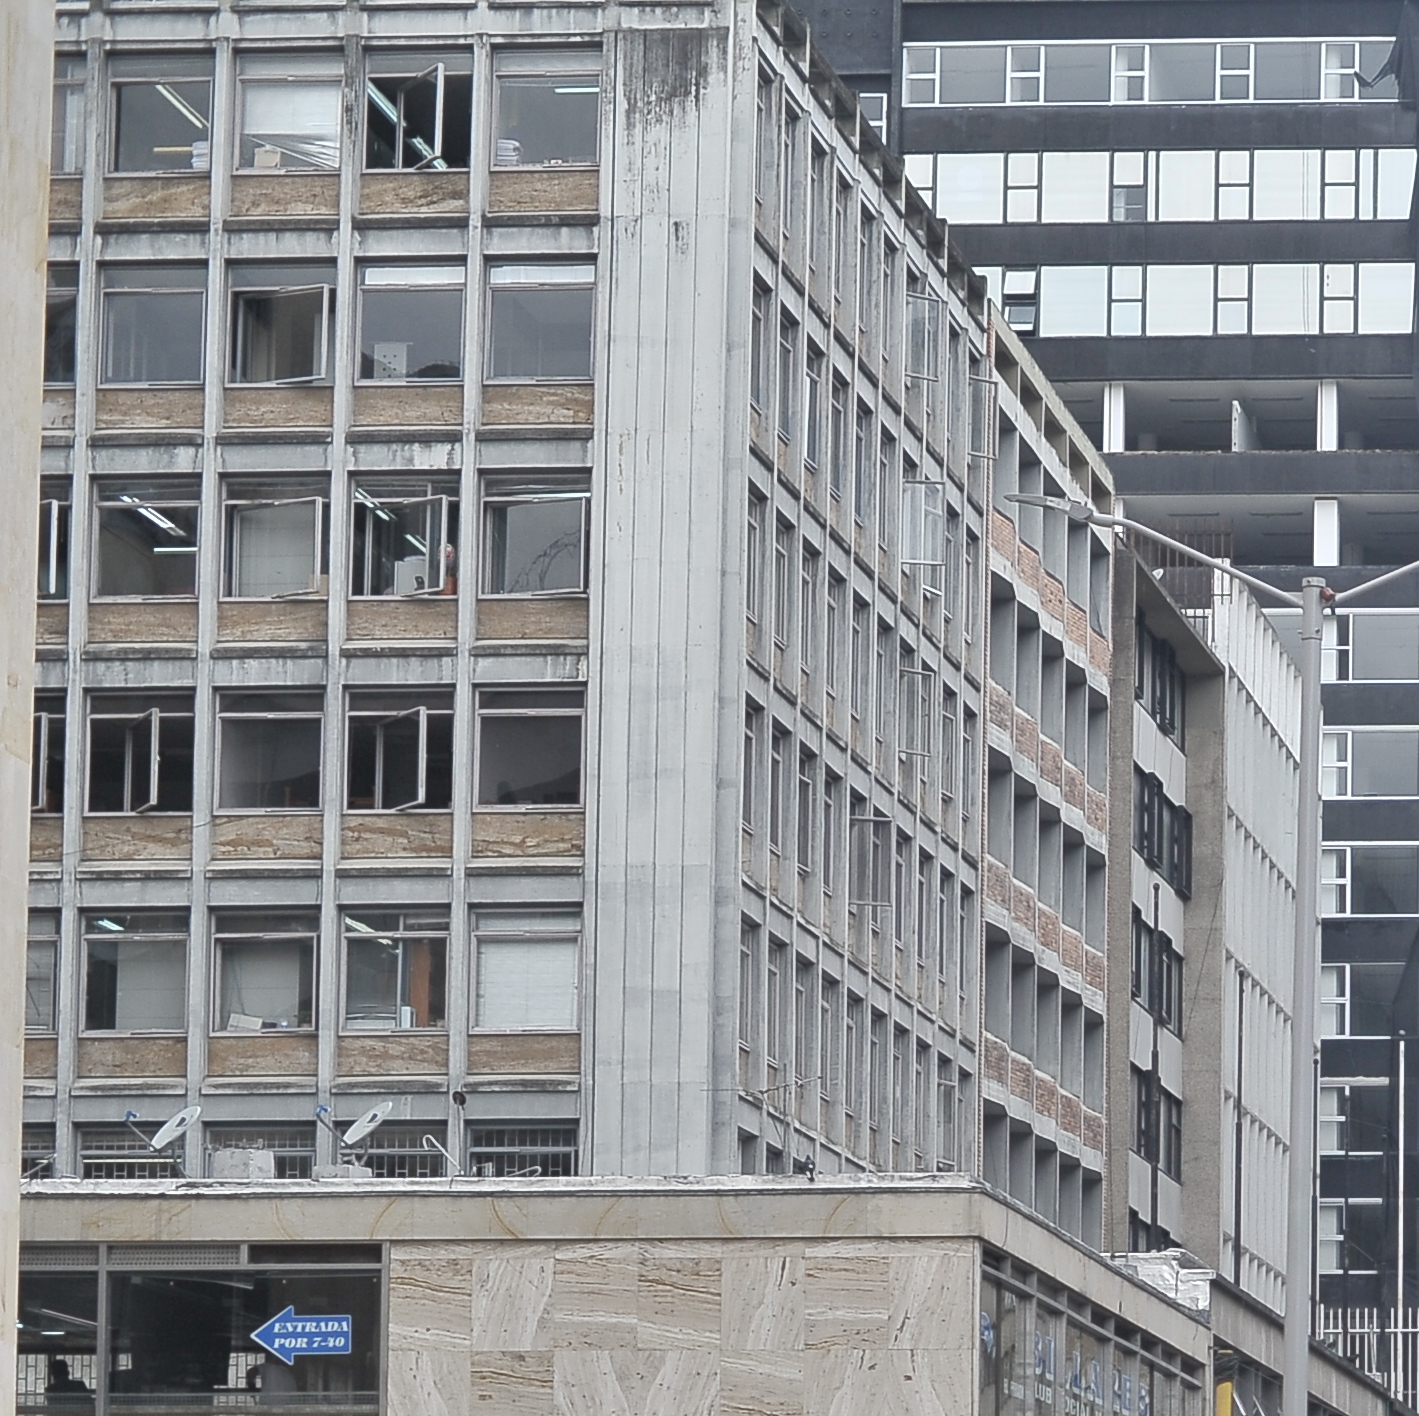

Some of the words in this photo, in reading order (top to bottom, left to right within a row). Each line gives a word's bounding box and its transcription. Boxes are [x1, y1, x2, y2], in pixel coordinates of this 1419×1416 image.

[273, 1321, 349, 1333] ENTRADA
[273, 1337, 308, 1349] POR
[1034, 1381, 1052, 1405] LUB
